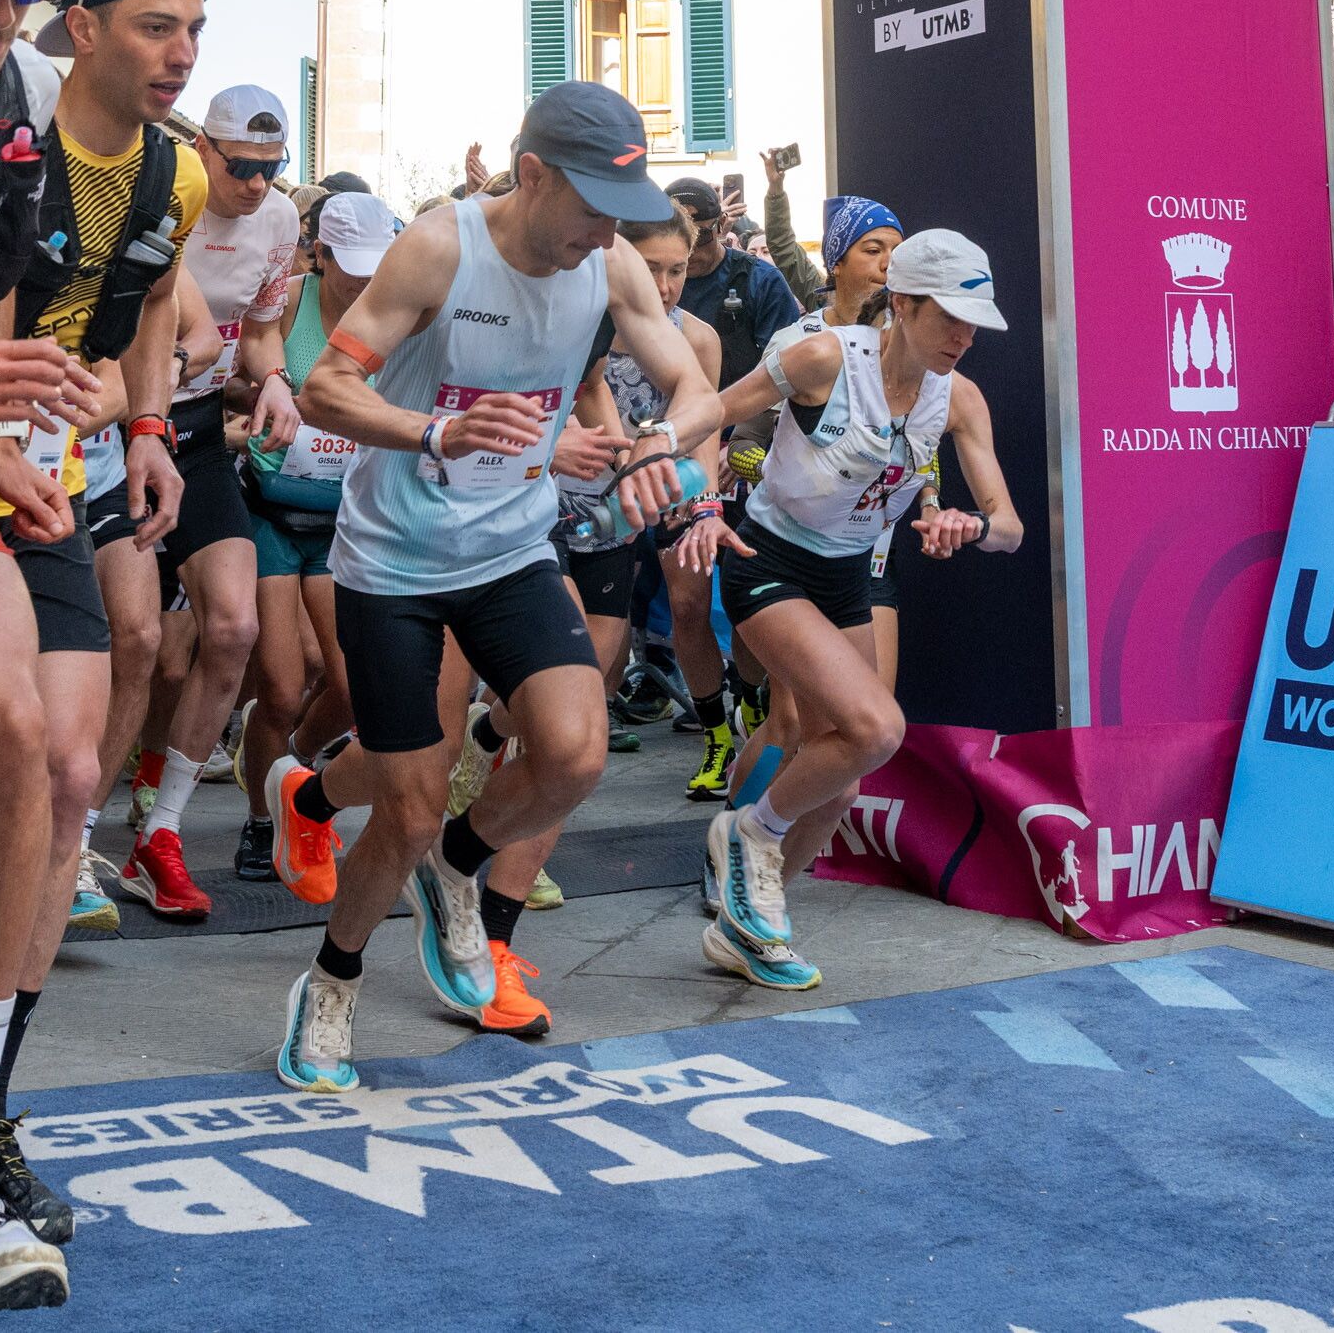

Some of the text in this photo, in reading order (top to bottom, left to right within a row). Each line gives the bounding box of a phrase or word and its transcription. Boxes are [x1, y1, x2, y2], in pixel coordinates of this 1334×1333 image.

[883, 9, 970, 44] BY UTMB
[1147, 195, 1247, 222] COMUNE
[205, 244, 236, 252] SALOMON
[453, 308, 510, 327] BROOKS
[311, 438, 356, 454] 3034
[1103, 427, 1185, 452] RADDA
[1190, 427, 1212, 451] IN
[318, 457, 343, 465] GISELA
[477, 456, 505, 465] ALEX
[848, 514, 872, 522] JULIA
[729, 840, 757, 924] BROOKS
[32, 1096, 359, 1148] SERIES
[68, 1096, 934, 1234] UTMB
